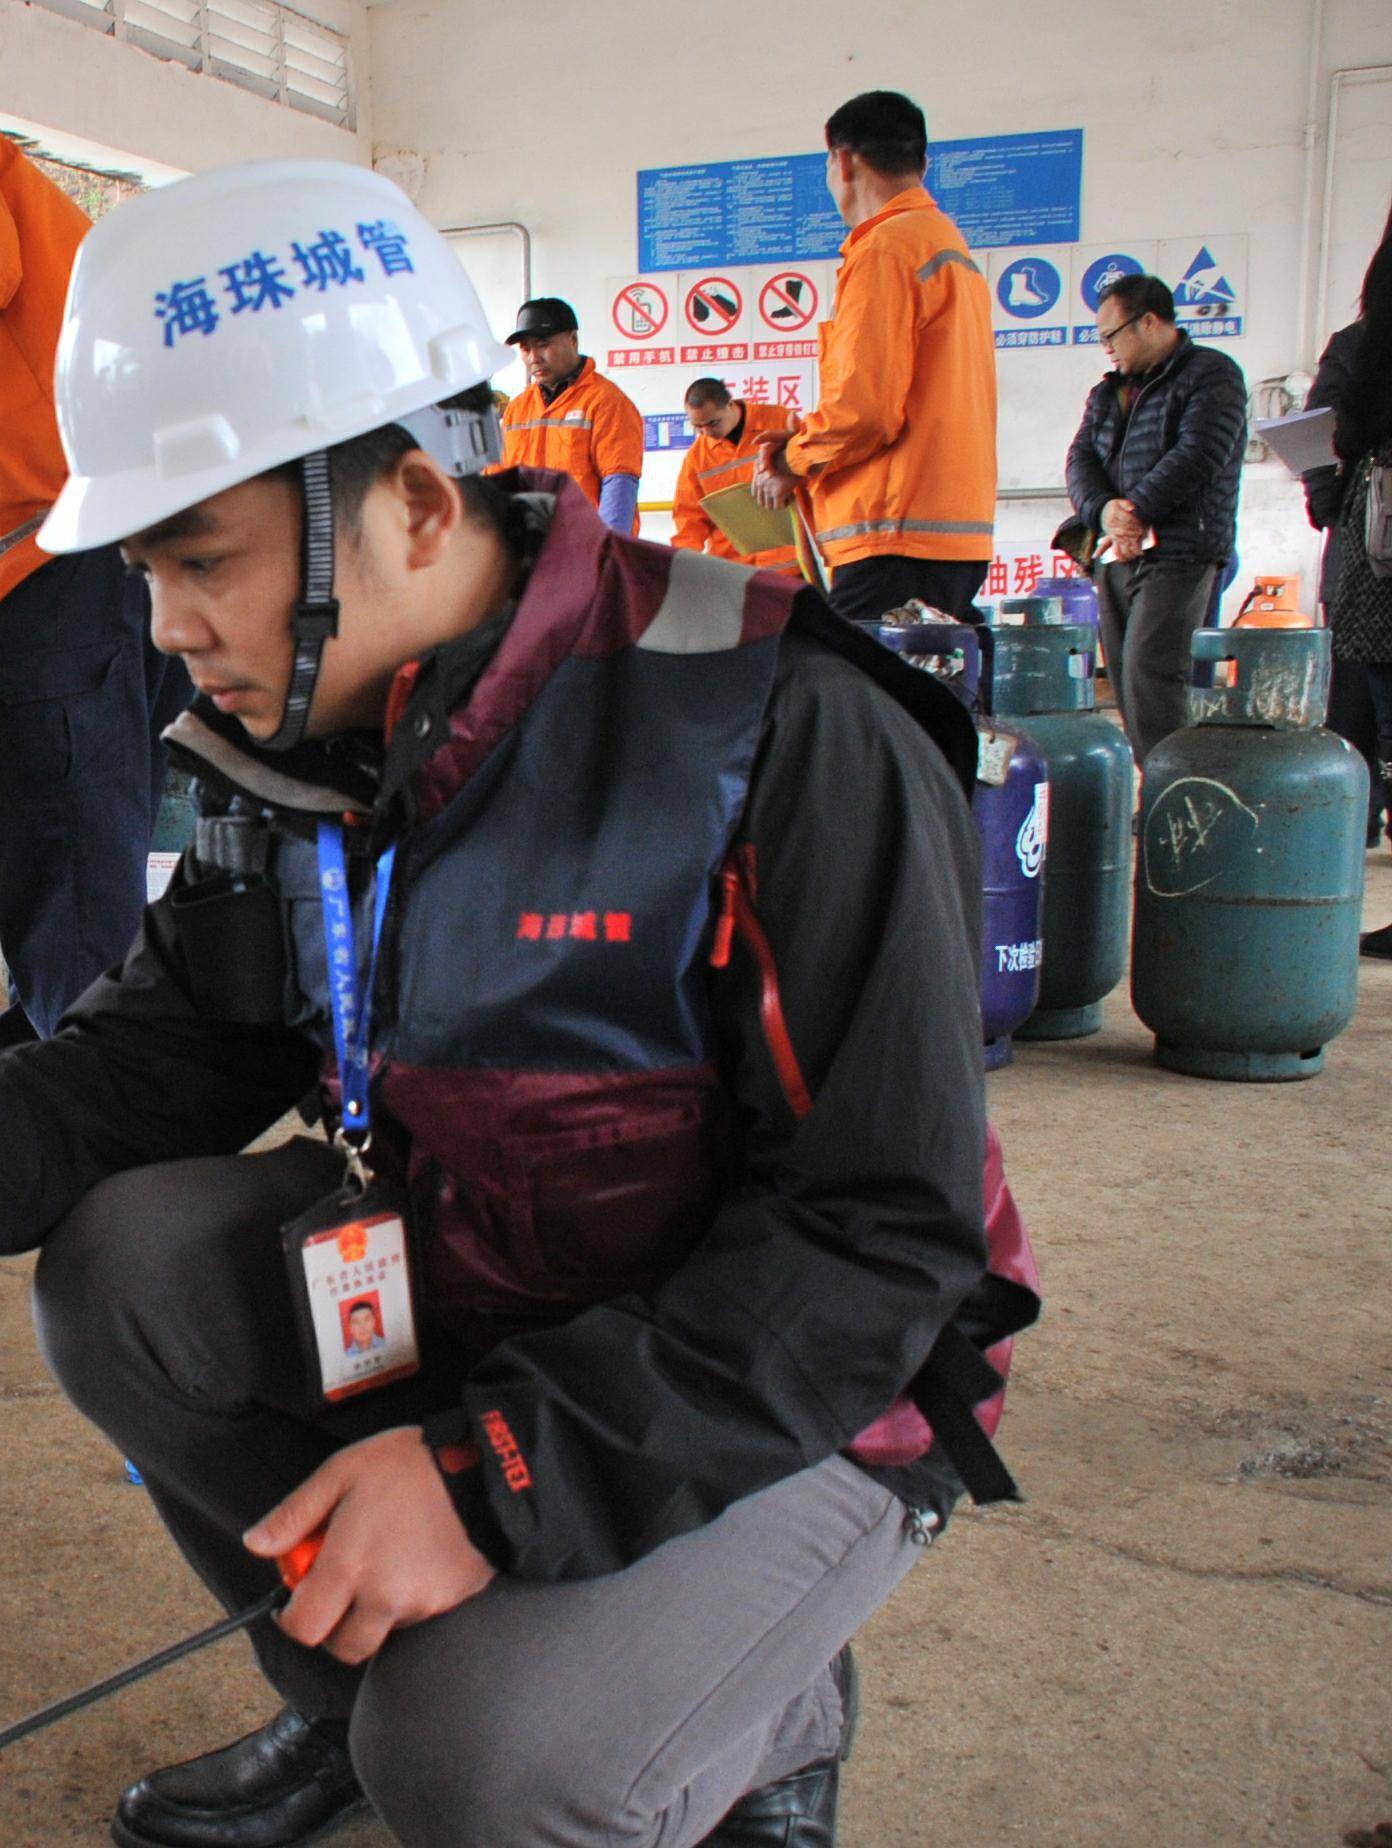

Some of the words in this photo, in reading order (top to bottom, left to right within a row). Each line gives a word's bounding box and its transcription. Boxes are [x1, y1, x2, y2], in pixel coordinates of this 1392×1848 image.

[155, 220, 414, 347] 海珠城管
[613, 349, 672, 365] 禁用手机
